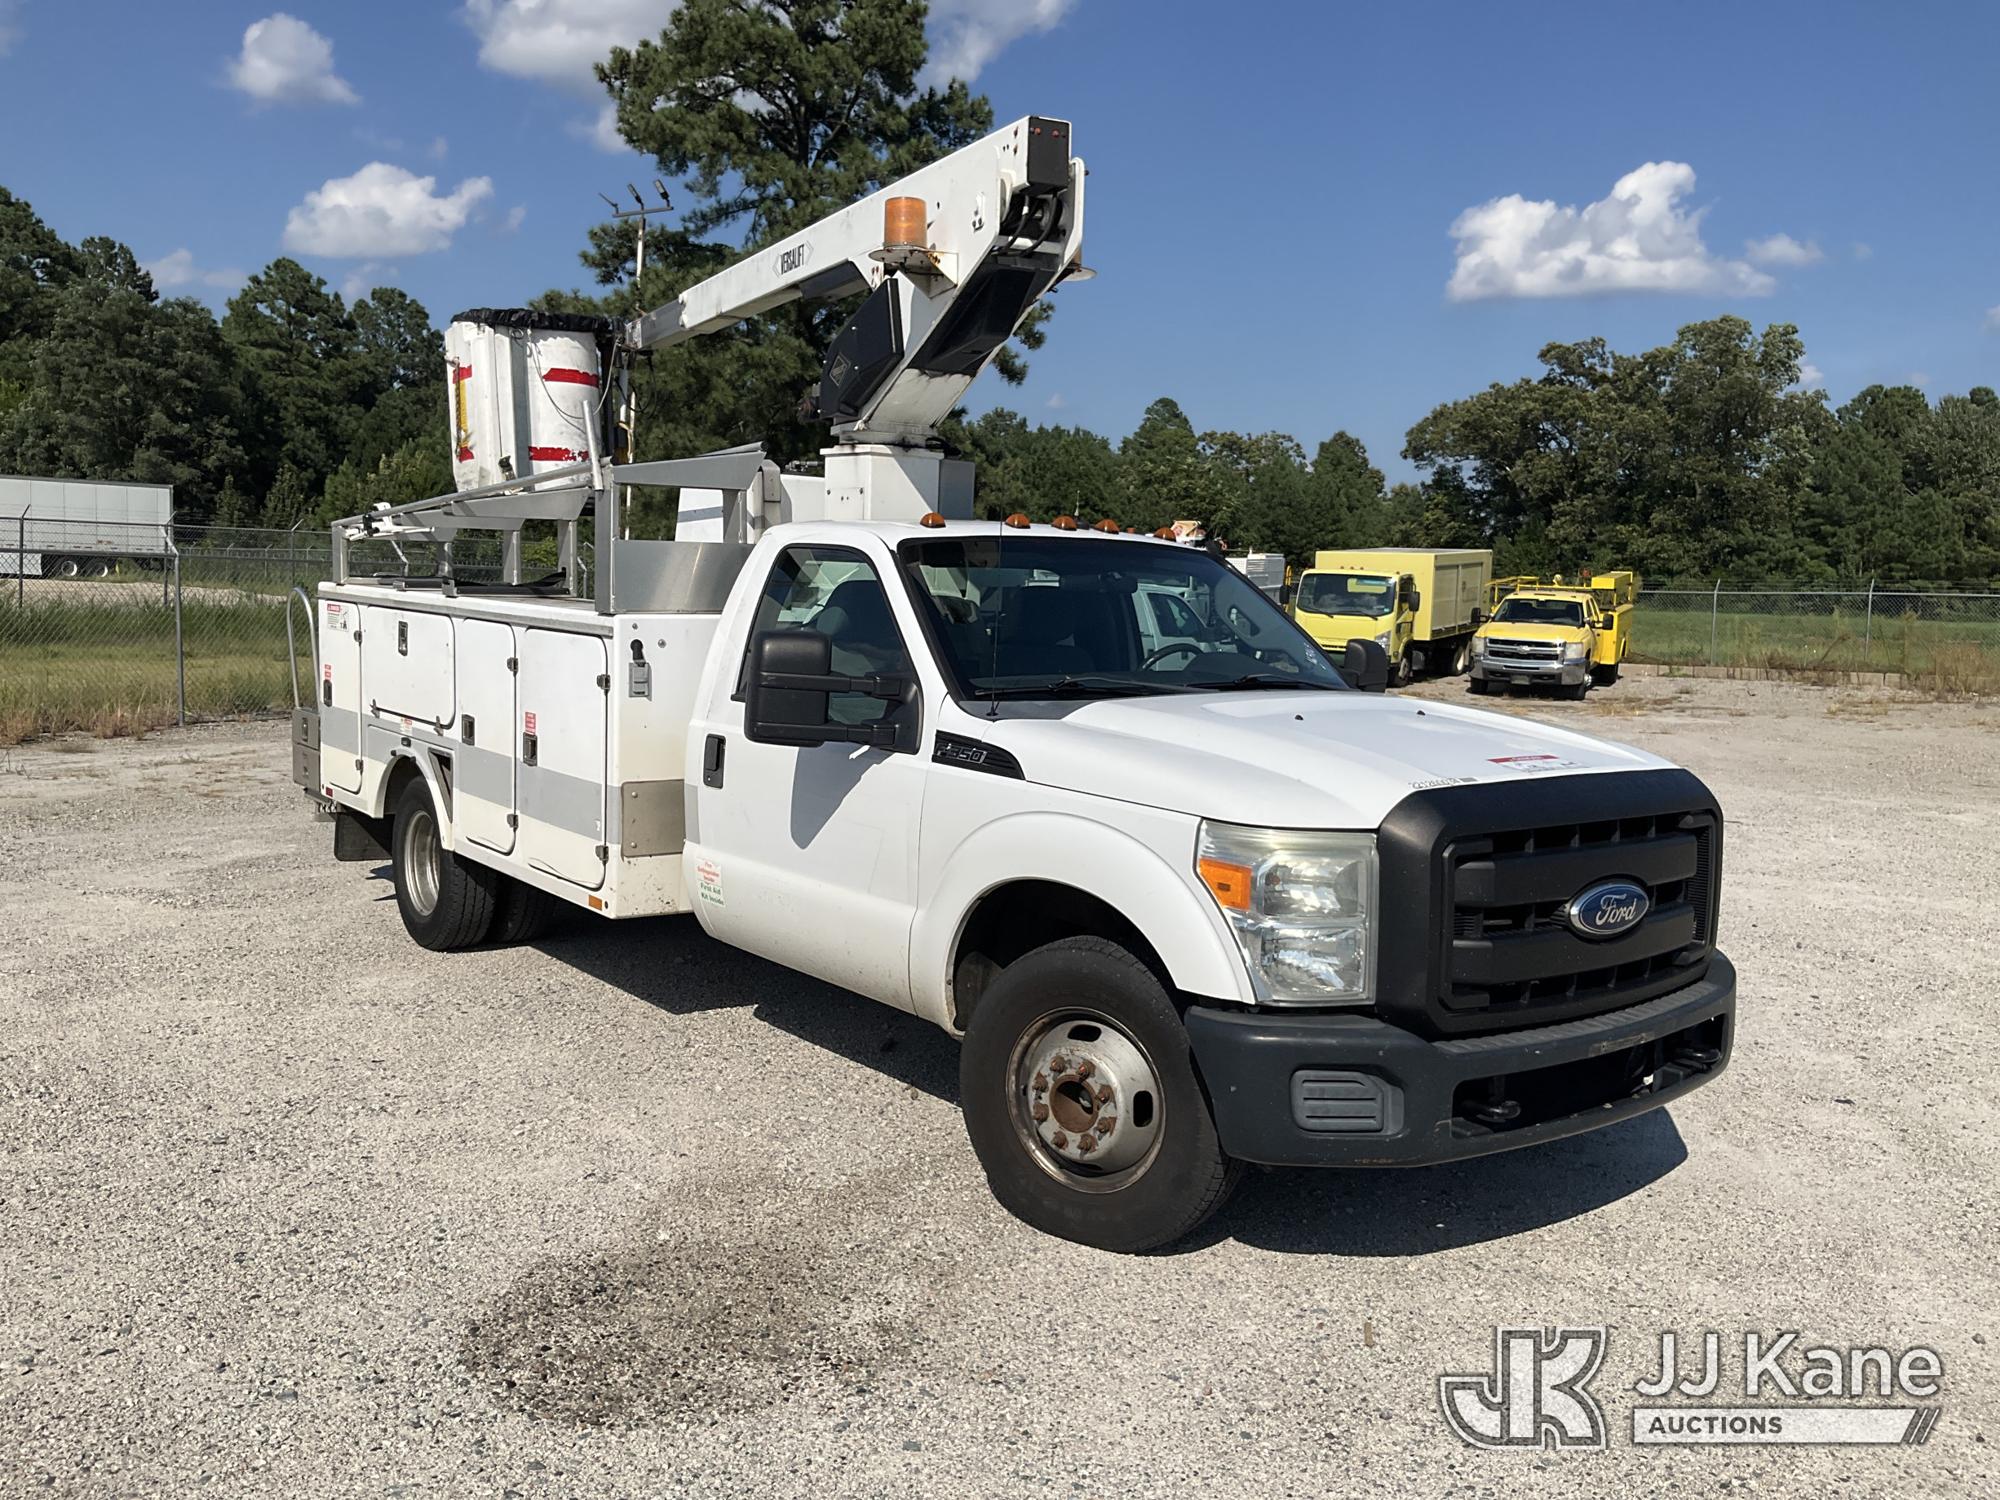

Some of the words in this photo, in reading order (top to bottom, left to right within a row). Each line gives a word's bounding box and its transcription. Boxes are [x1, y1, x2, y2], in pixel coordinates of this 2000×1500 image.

[780, 243, 805, 275] VERSALIFT
[700, 881, 712, 892] First
[1595, 893, 1637, 926] Ford
